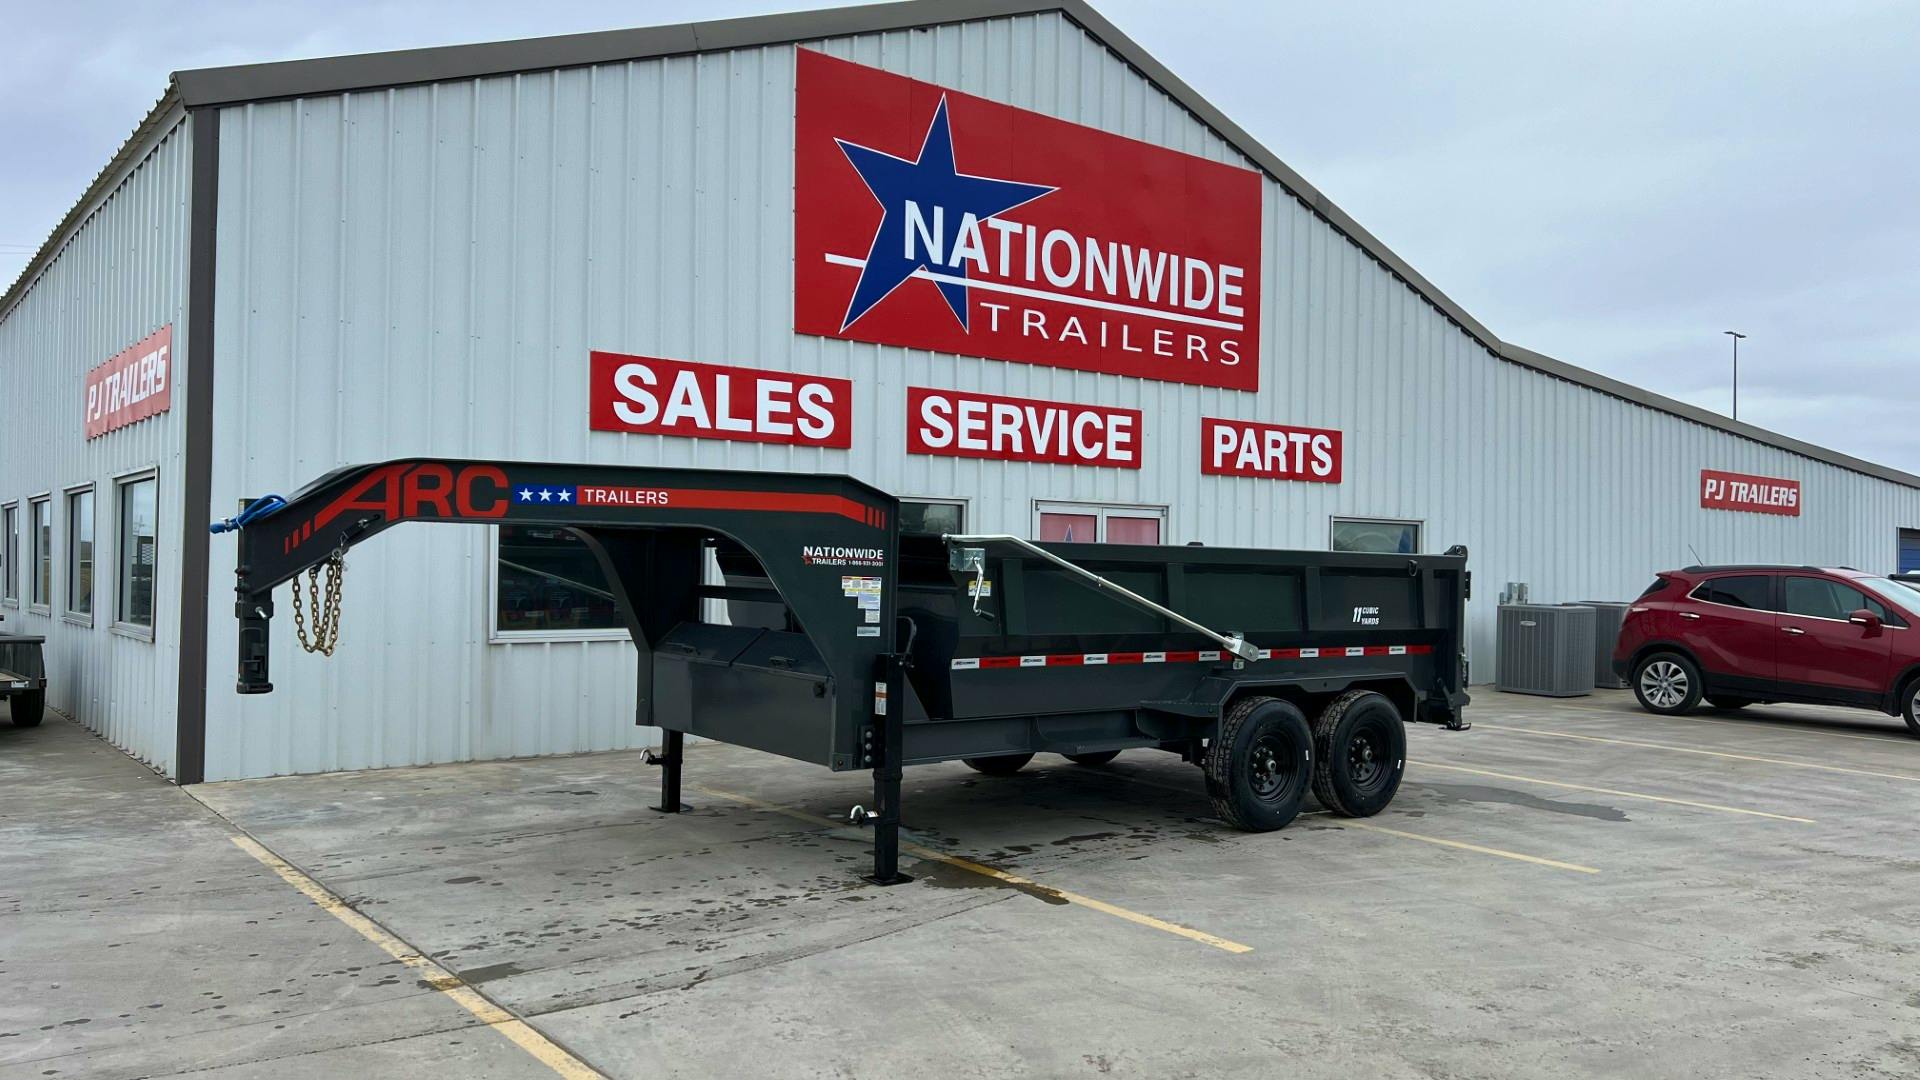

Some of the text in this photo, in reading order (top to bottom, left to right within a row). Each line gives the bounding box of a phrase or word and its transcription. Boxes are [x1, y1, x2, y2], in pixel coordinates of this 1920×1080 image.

[904, 199, 1244, 318] NATIONWIDE
[979, 301, 1241, 366] TRAILERS
[87, 344, 168, 423] PJ TRAILERS
[612, 363, 835, 439] SALES
[919, 396, 1133, 462] SERVICE
[1213, 425, 1333, 475] PARTS
[314, 463, 509, 532] ARC
[584, 488, 669, 507] TRAILERS
[1704, 478, 1798, 507] PJ TRAILERS
[803, 546, 884, 560] NATIONWIDE
[812, 558, 846, 566] TRAILERS
[1352, 606, 1379, 622] 11 CUBIC
